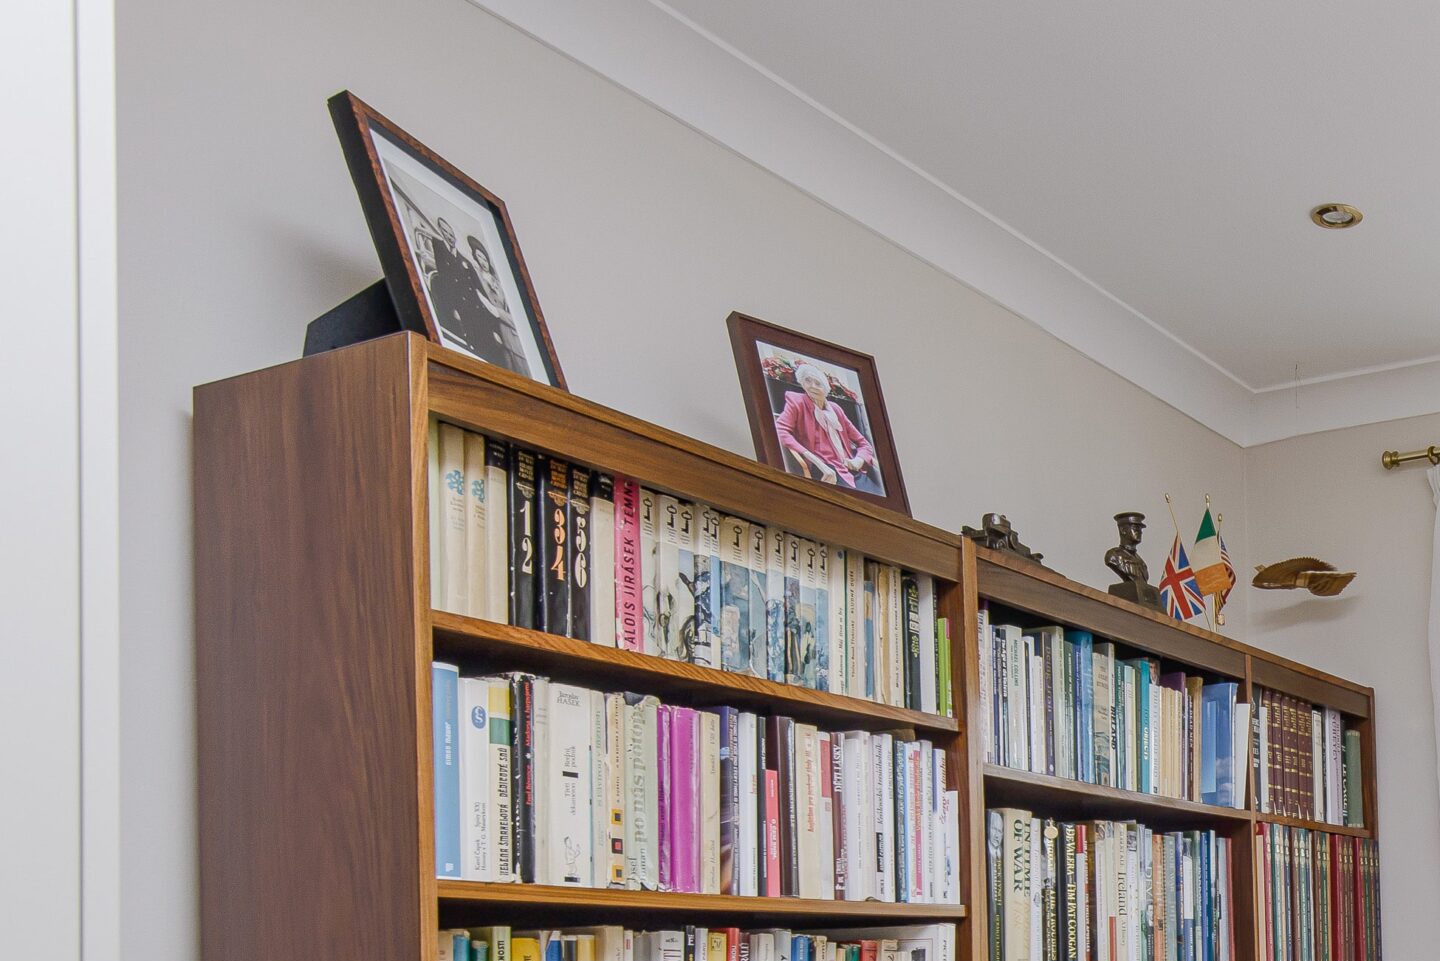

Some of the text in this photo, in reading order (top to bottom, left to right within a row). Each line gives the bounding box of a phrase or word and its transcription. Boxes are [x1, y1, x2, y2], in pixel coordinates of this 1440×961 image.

[520, 500, 532, 537] 1
[554, 508, 565, 545] 3
[522, 537, 533, 574] 2
[550, 545, 566, 581] 4
[621, 537, 636, 598] JIRÁSEK
[622, 602, 636, 645] ALOIS
[1024, 822, 1030, 843] IN
[1013, 819, 1023, 893] OF WAR
[1067, 882, 1076, 899] TIM
[1117, 872, 1127, 916] Ireland
[1067, 902, 1076, 919] PAT
[1068, 920, 1077, 959] COOGAN
